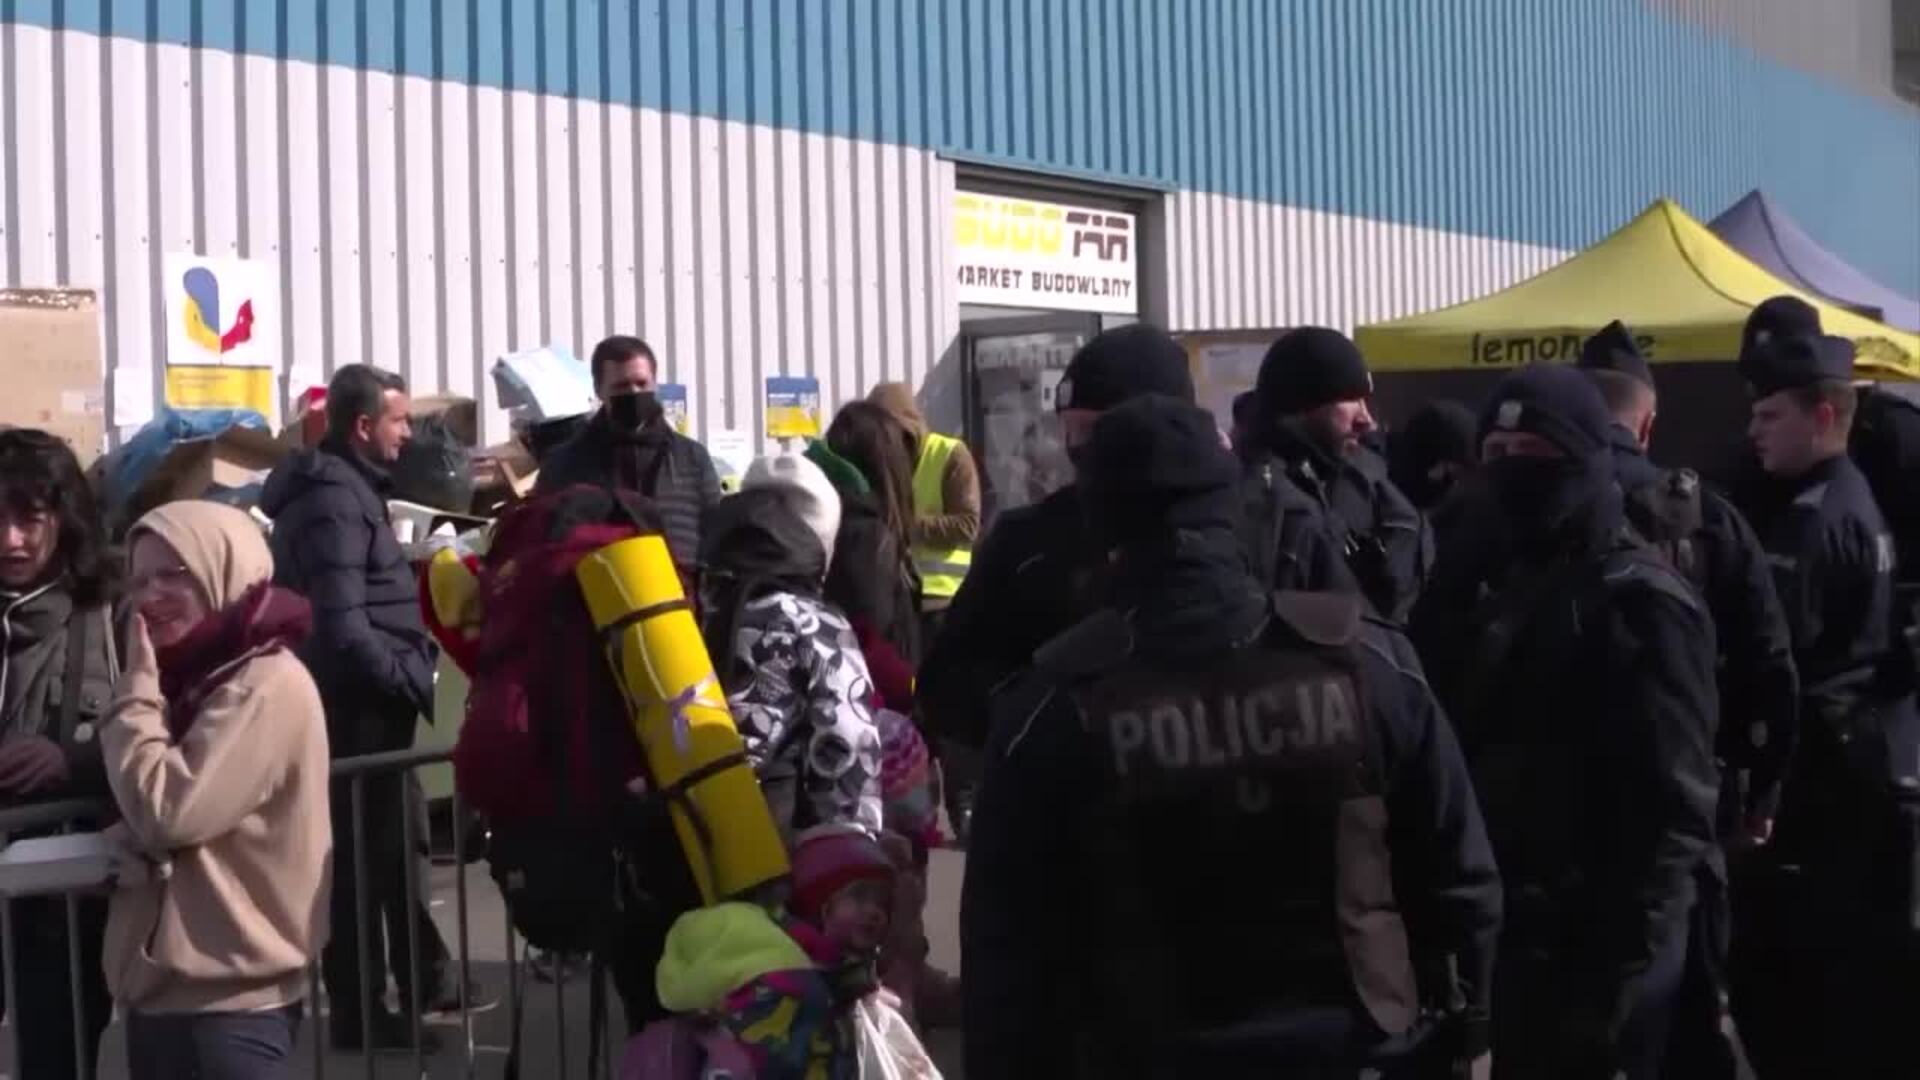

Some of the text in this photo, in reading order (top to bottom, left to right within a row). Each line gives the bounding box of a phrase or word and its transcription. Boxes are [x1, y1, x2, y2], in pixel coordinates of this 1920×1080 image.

[1031, 271, 1131, 298] BUDOWLANY
[1472, 333, 1655, 363] lemone
[1109, 680, 1355, 775] POLICJA
